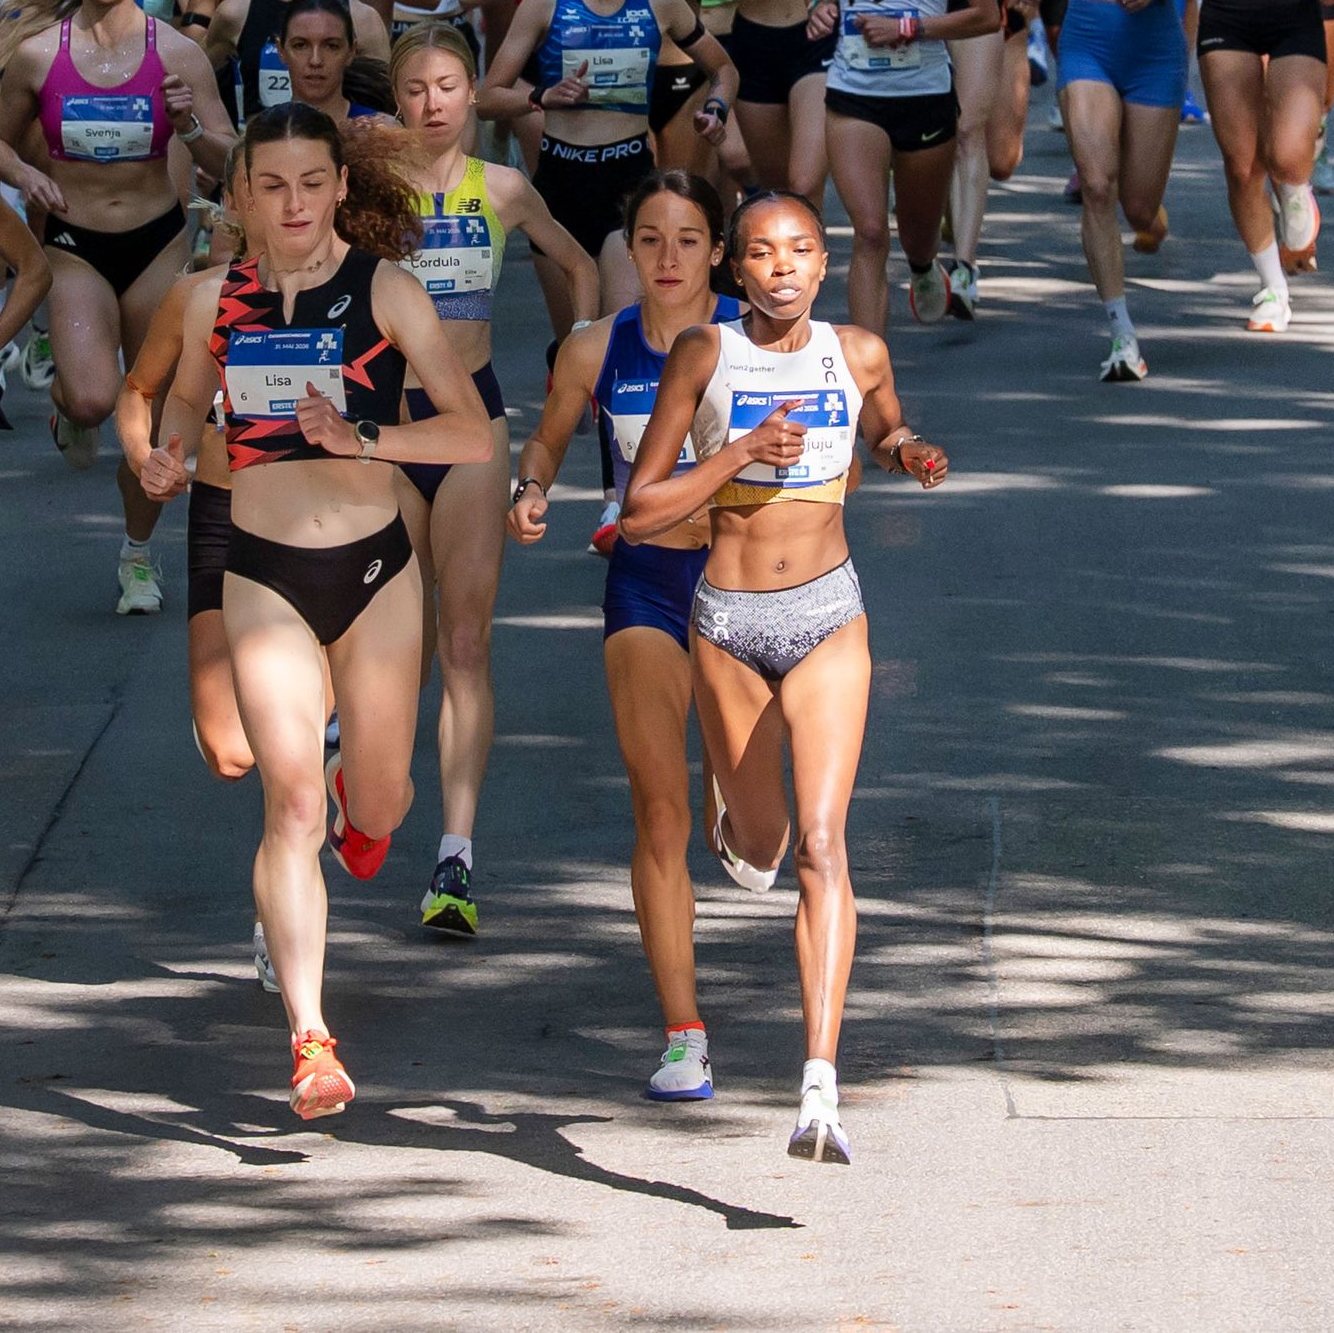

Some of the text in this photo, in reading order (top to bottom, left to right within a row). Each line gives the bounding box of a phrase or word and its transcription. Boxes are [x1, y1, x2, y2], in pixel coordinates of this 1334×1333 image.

[593, 56, 614, 66] Lisa
[85, 128, 121, 139] Svenja
[552, 143, 599, 163] NIKE
[601, 140, 643, 162] PRO
[410, 256, 461, 269] Cordula
[265, 374, 292, 387] Lisa
[240, 392, 248, 401] 6
